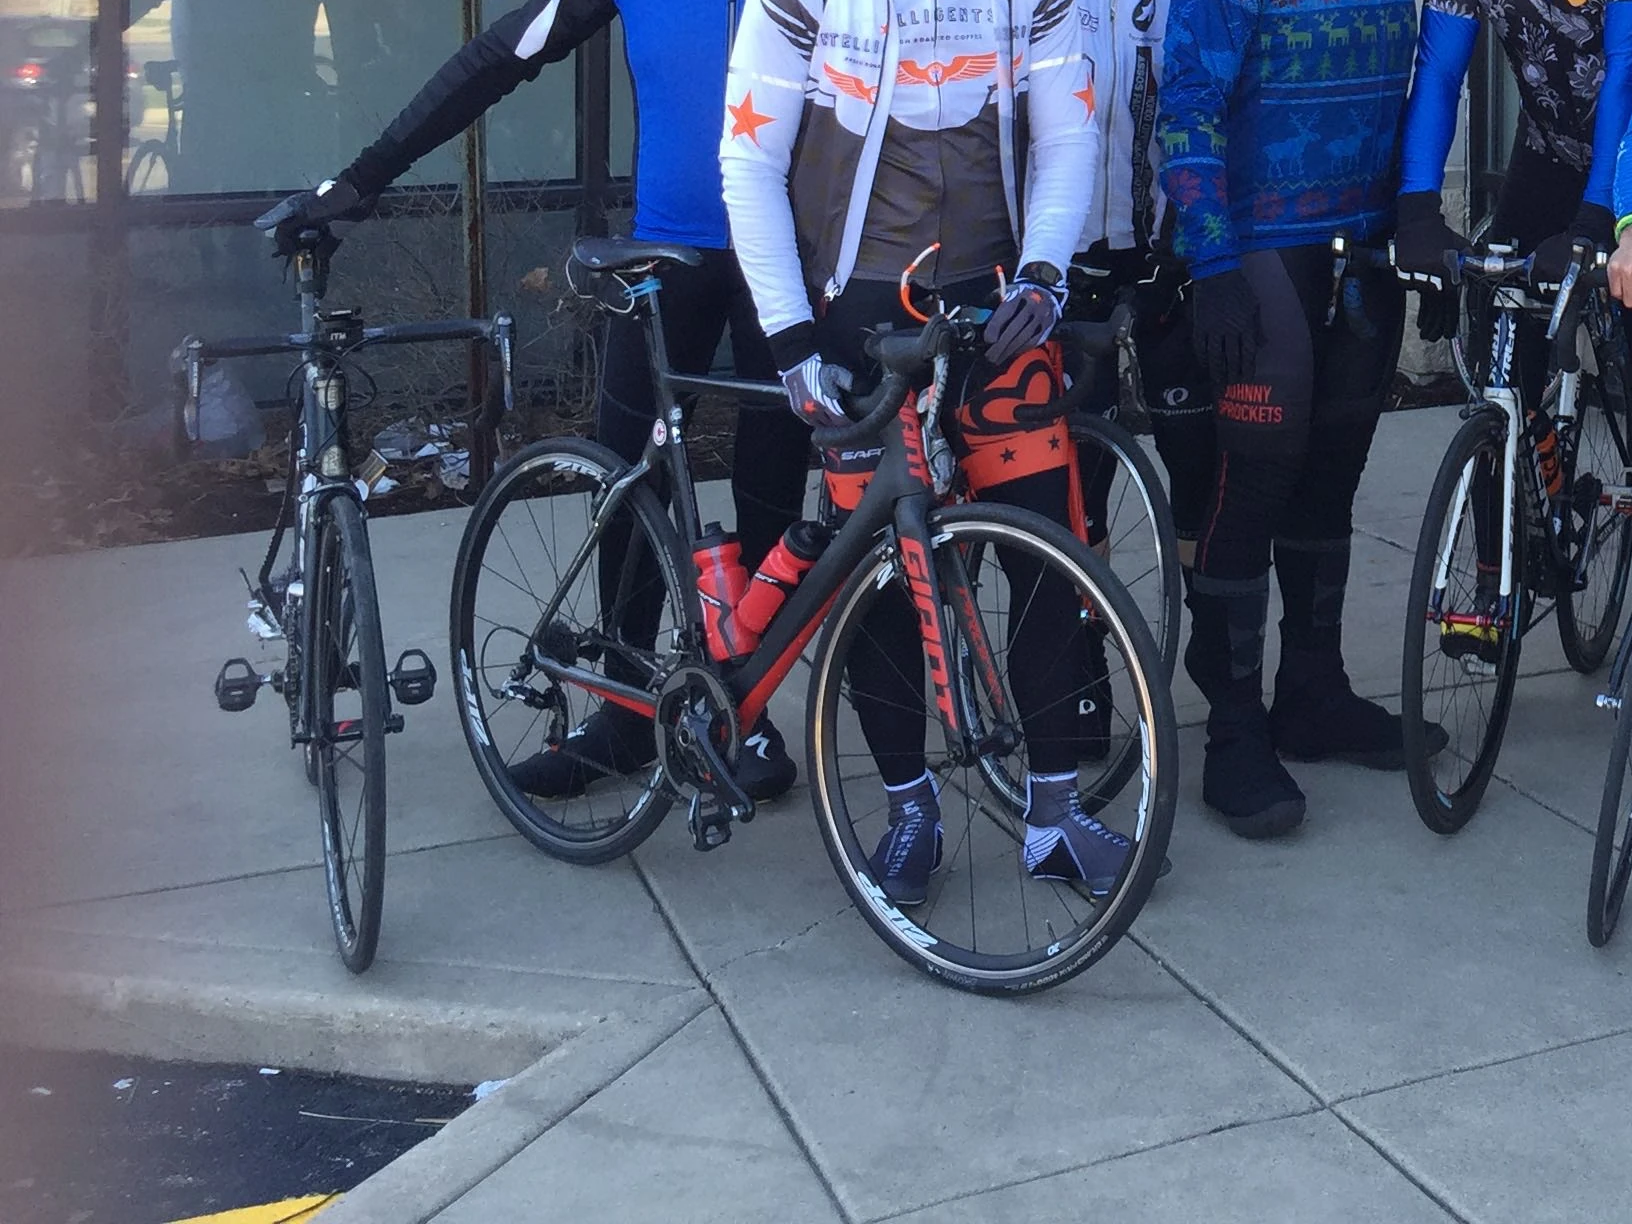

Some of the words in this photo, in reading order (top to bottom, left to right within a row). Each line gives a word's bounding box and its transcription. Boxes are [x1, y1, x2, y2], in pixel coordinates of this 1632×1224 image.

[1224, 383, 1272, 404] JOHNNY
[900, 535, 958, 732] GIANT
[857, 870, 939, 948] ZIPP
